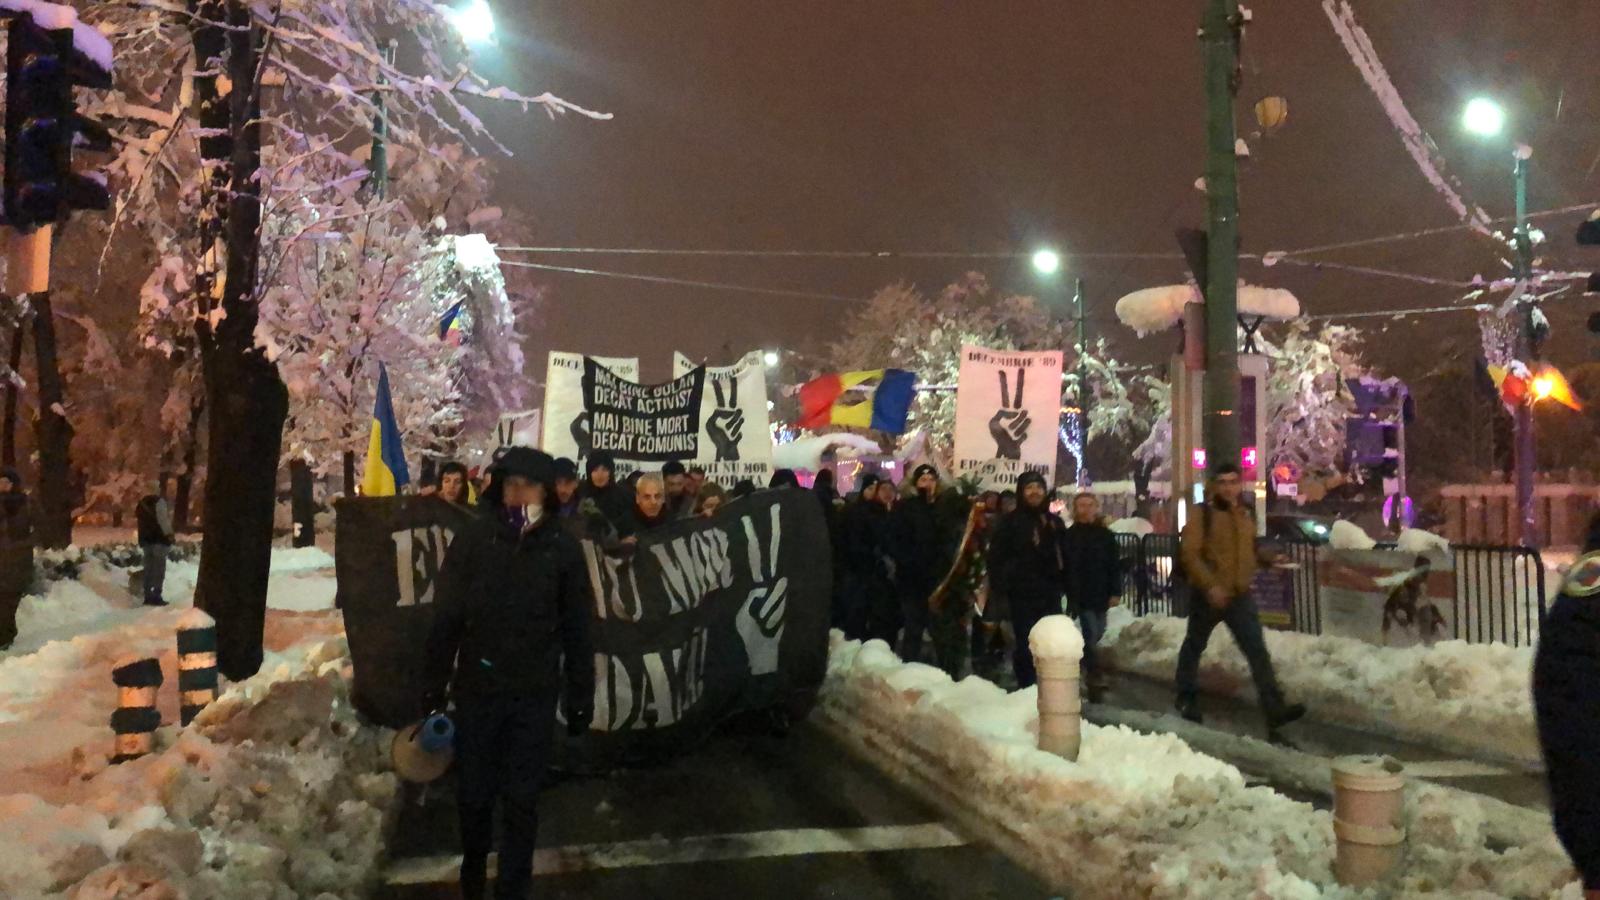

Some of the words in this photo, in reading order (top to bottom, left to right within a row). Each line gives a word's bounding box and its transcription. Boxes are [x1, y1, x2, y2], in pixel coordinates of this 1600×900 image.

[594, 385, 633, 410] DECAT
[637, 388, 693, 414] ACTIVIST
[593, 411, 619, 432] MAI
[622, 415, 653, 436] BINE
[656, 414, 690, 436] MORT
[592, 431, 635, 452] DECAT
